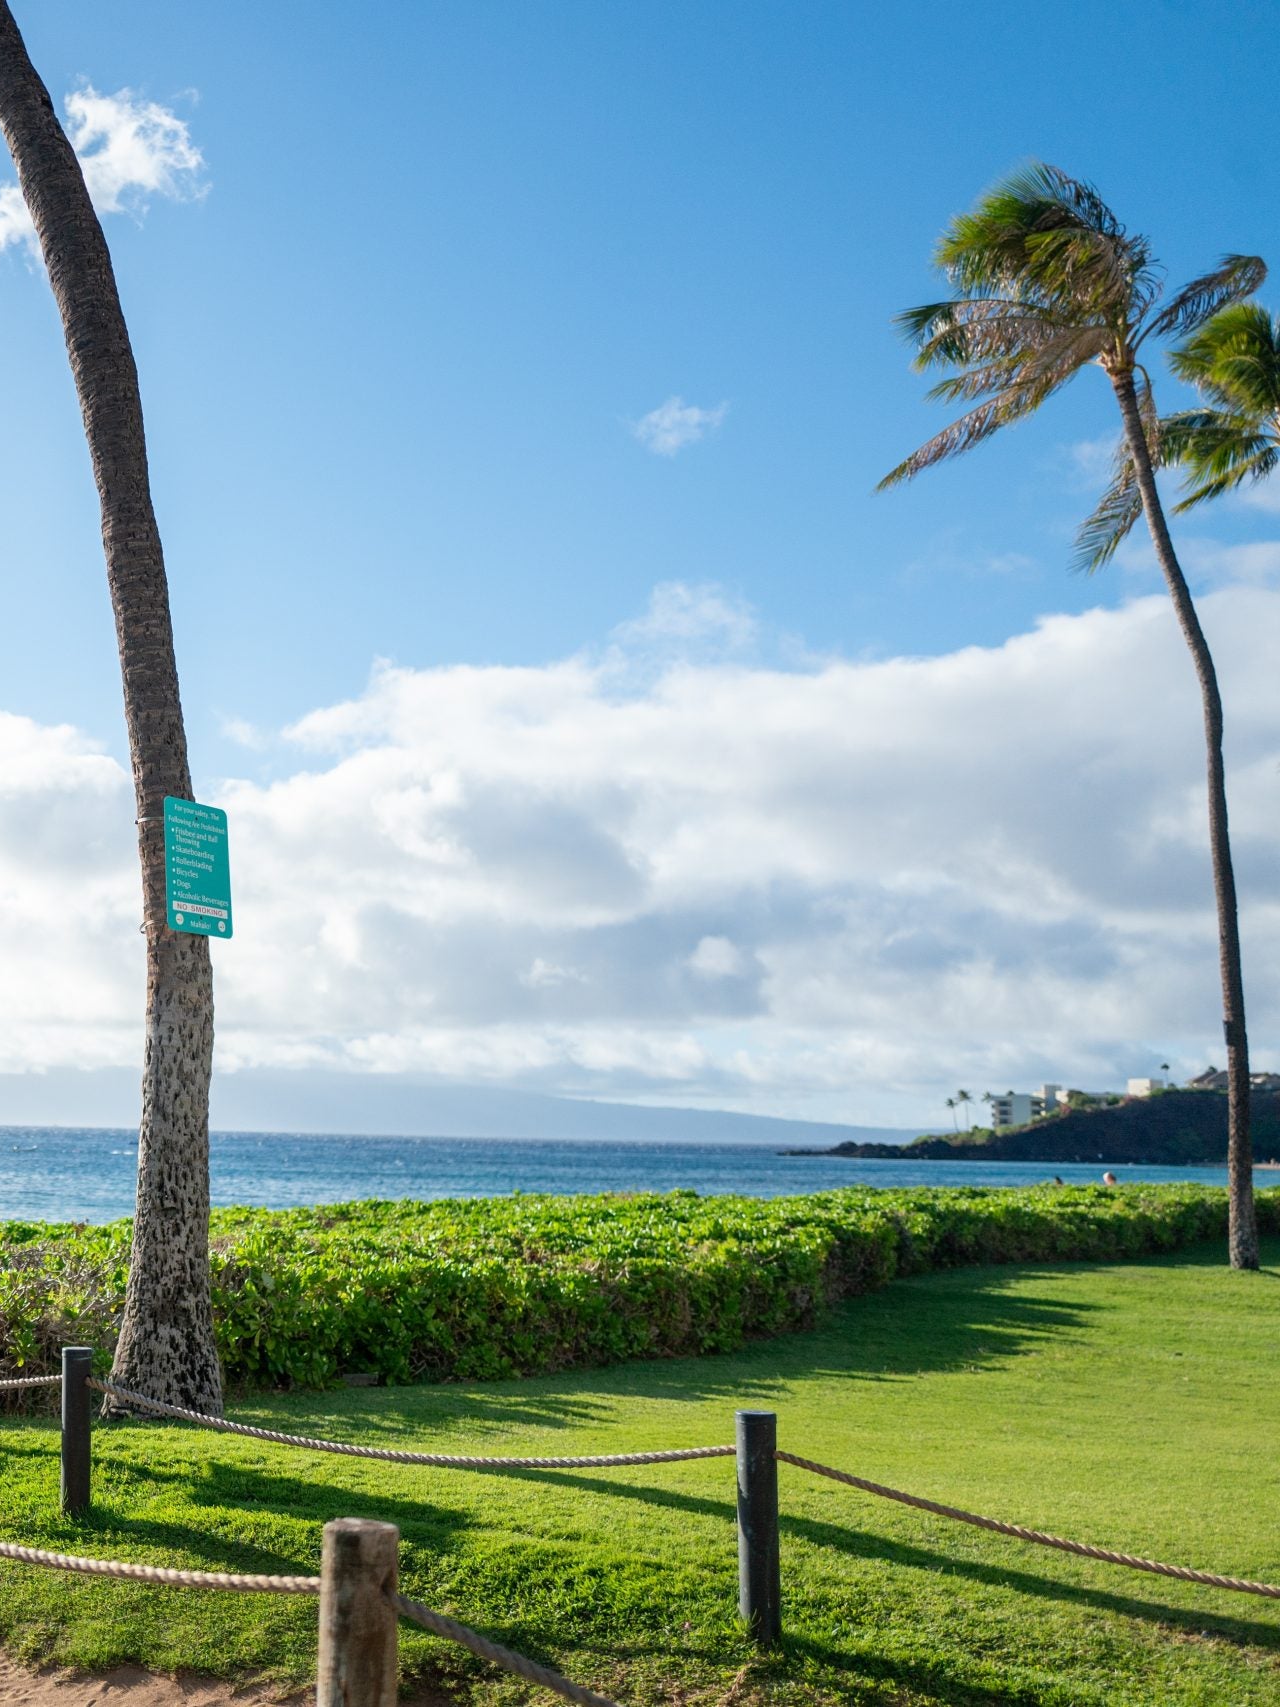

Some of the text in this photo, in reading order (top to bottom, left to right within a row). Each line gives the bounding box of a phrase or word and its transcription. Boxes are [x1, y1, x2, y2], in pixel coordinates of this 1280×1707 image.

[168, 814, 191, 828] Following
[176, 827, 218, 843] Frisbee and Ball
[176, 835, 200, 849] Throwing
[176, 845, 215, 862] Skateboarding
[176, 857, 213, 873] Rollerblading
[176, 868, 199, 879] Bicycles
[177, 879, 191, 890] Dogs
[178, 891, 229, 908] Alcoholic Beverages
[176, 902, 223, 917] NO SMOKING
